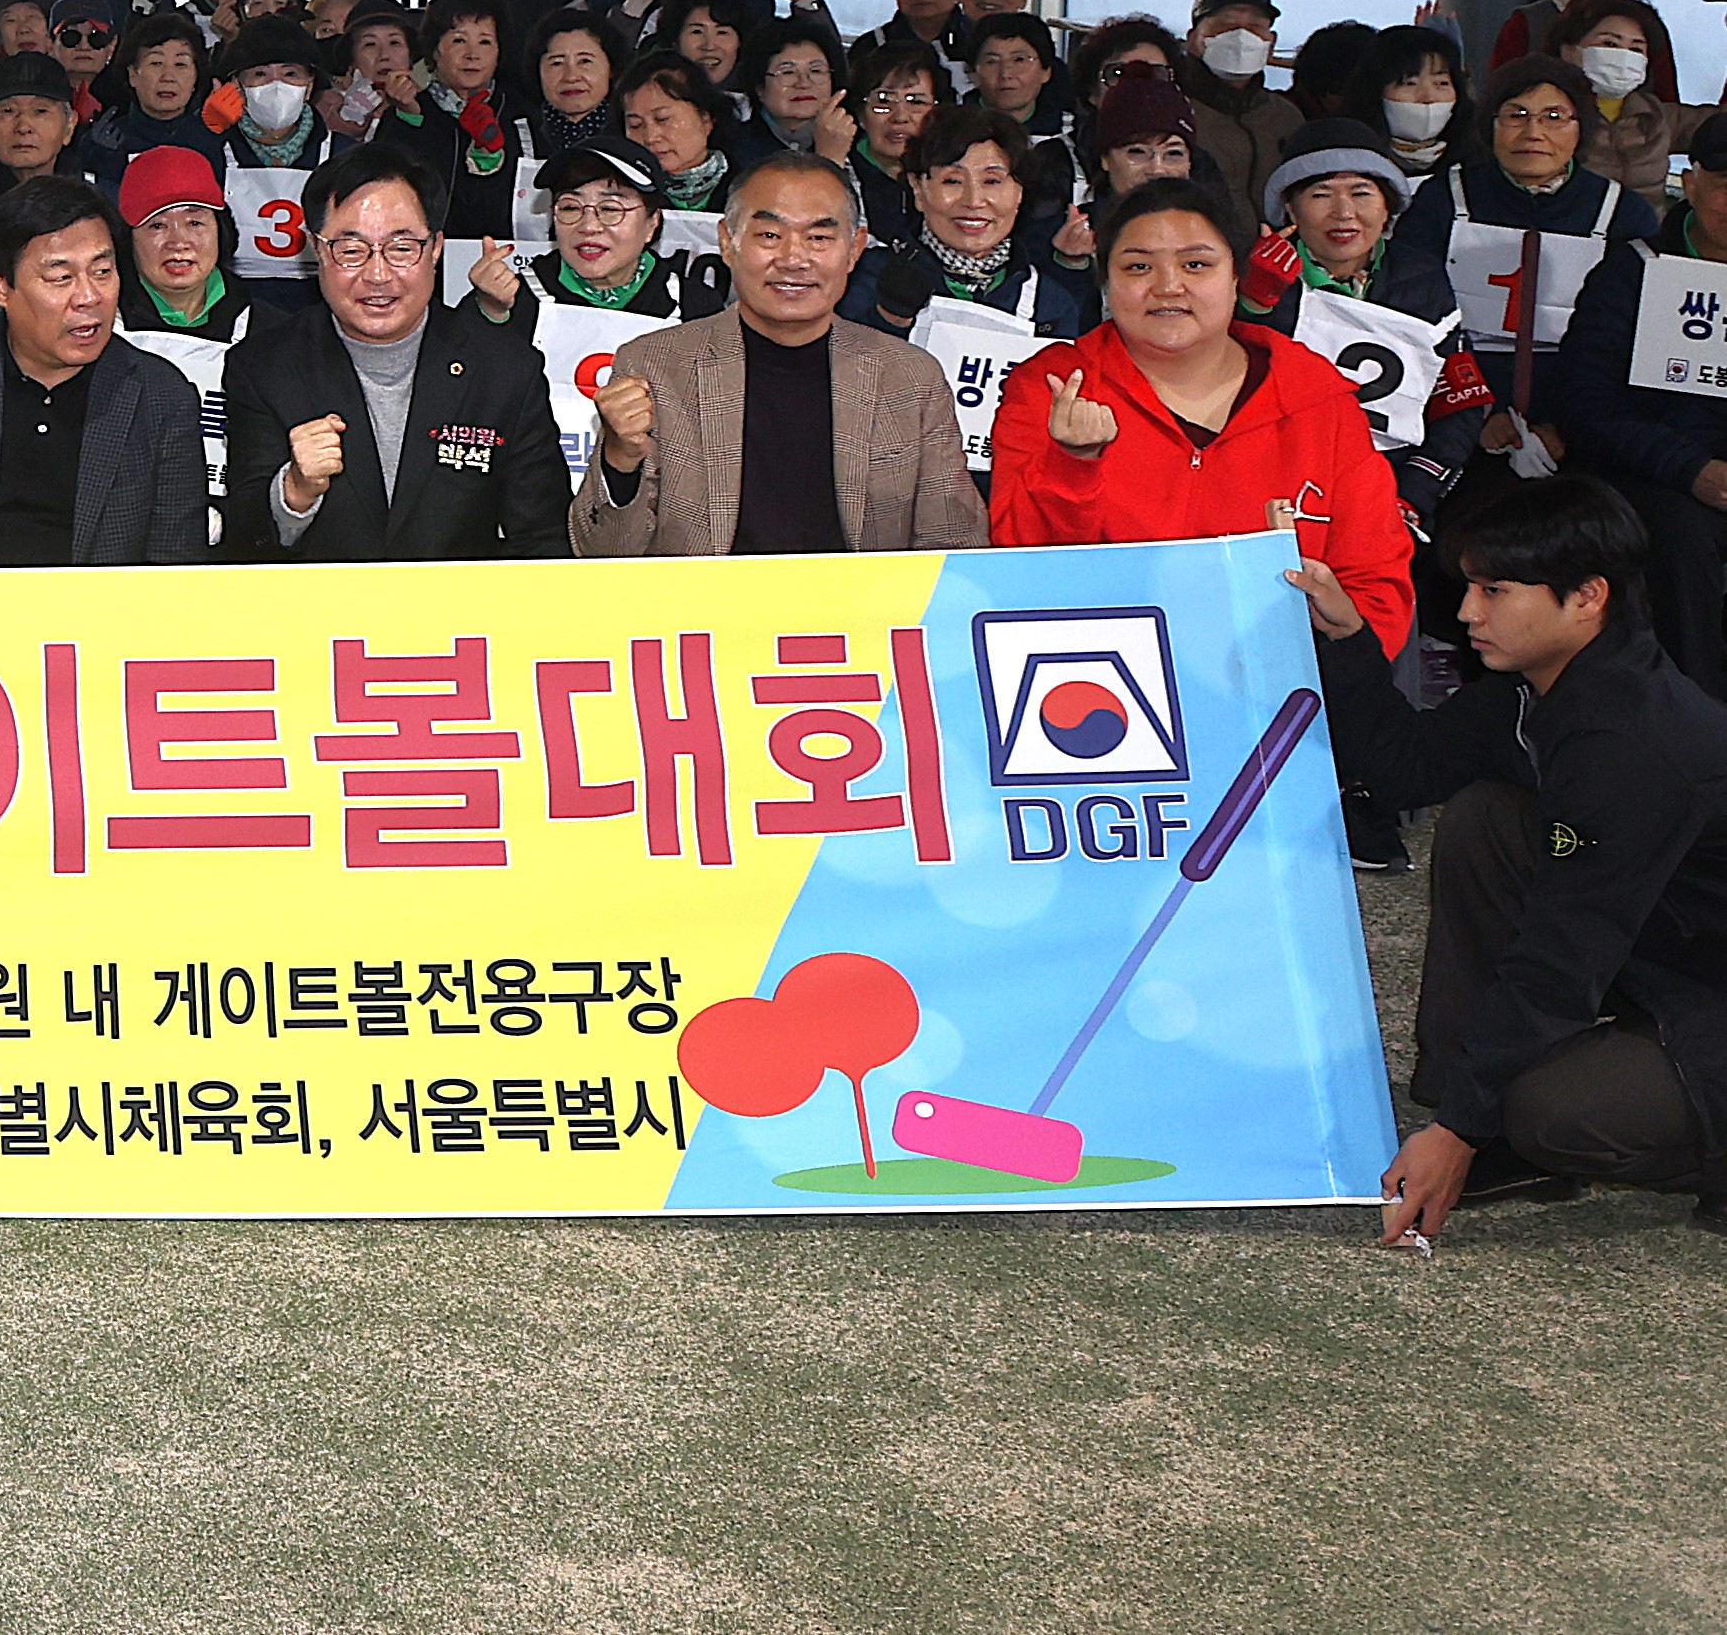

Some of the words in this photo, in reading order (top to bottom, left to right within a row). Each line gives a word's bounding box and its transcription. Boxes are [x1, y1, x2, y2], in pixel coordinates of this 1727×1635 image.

[255, 200, 308, 258] 3
[1487, 267, 1523, 333] 1
[1335, 342, 1405, 433] 2
[437, 424, 496, 447] 시의원
[1006, 794, 1192, 863] DGF
[63, 963, 120, 1040] 내
[154, 957, 681, 1041] 게이트볼전용구장
[358, 1076, 687, 1154] 서울특별시
